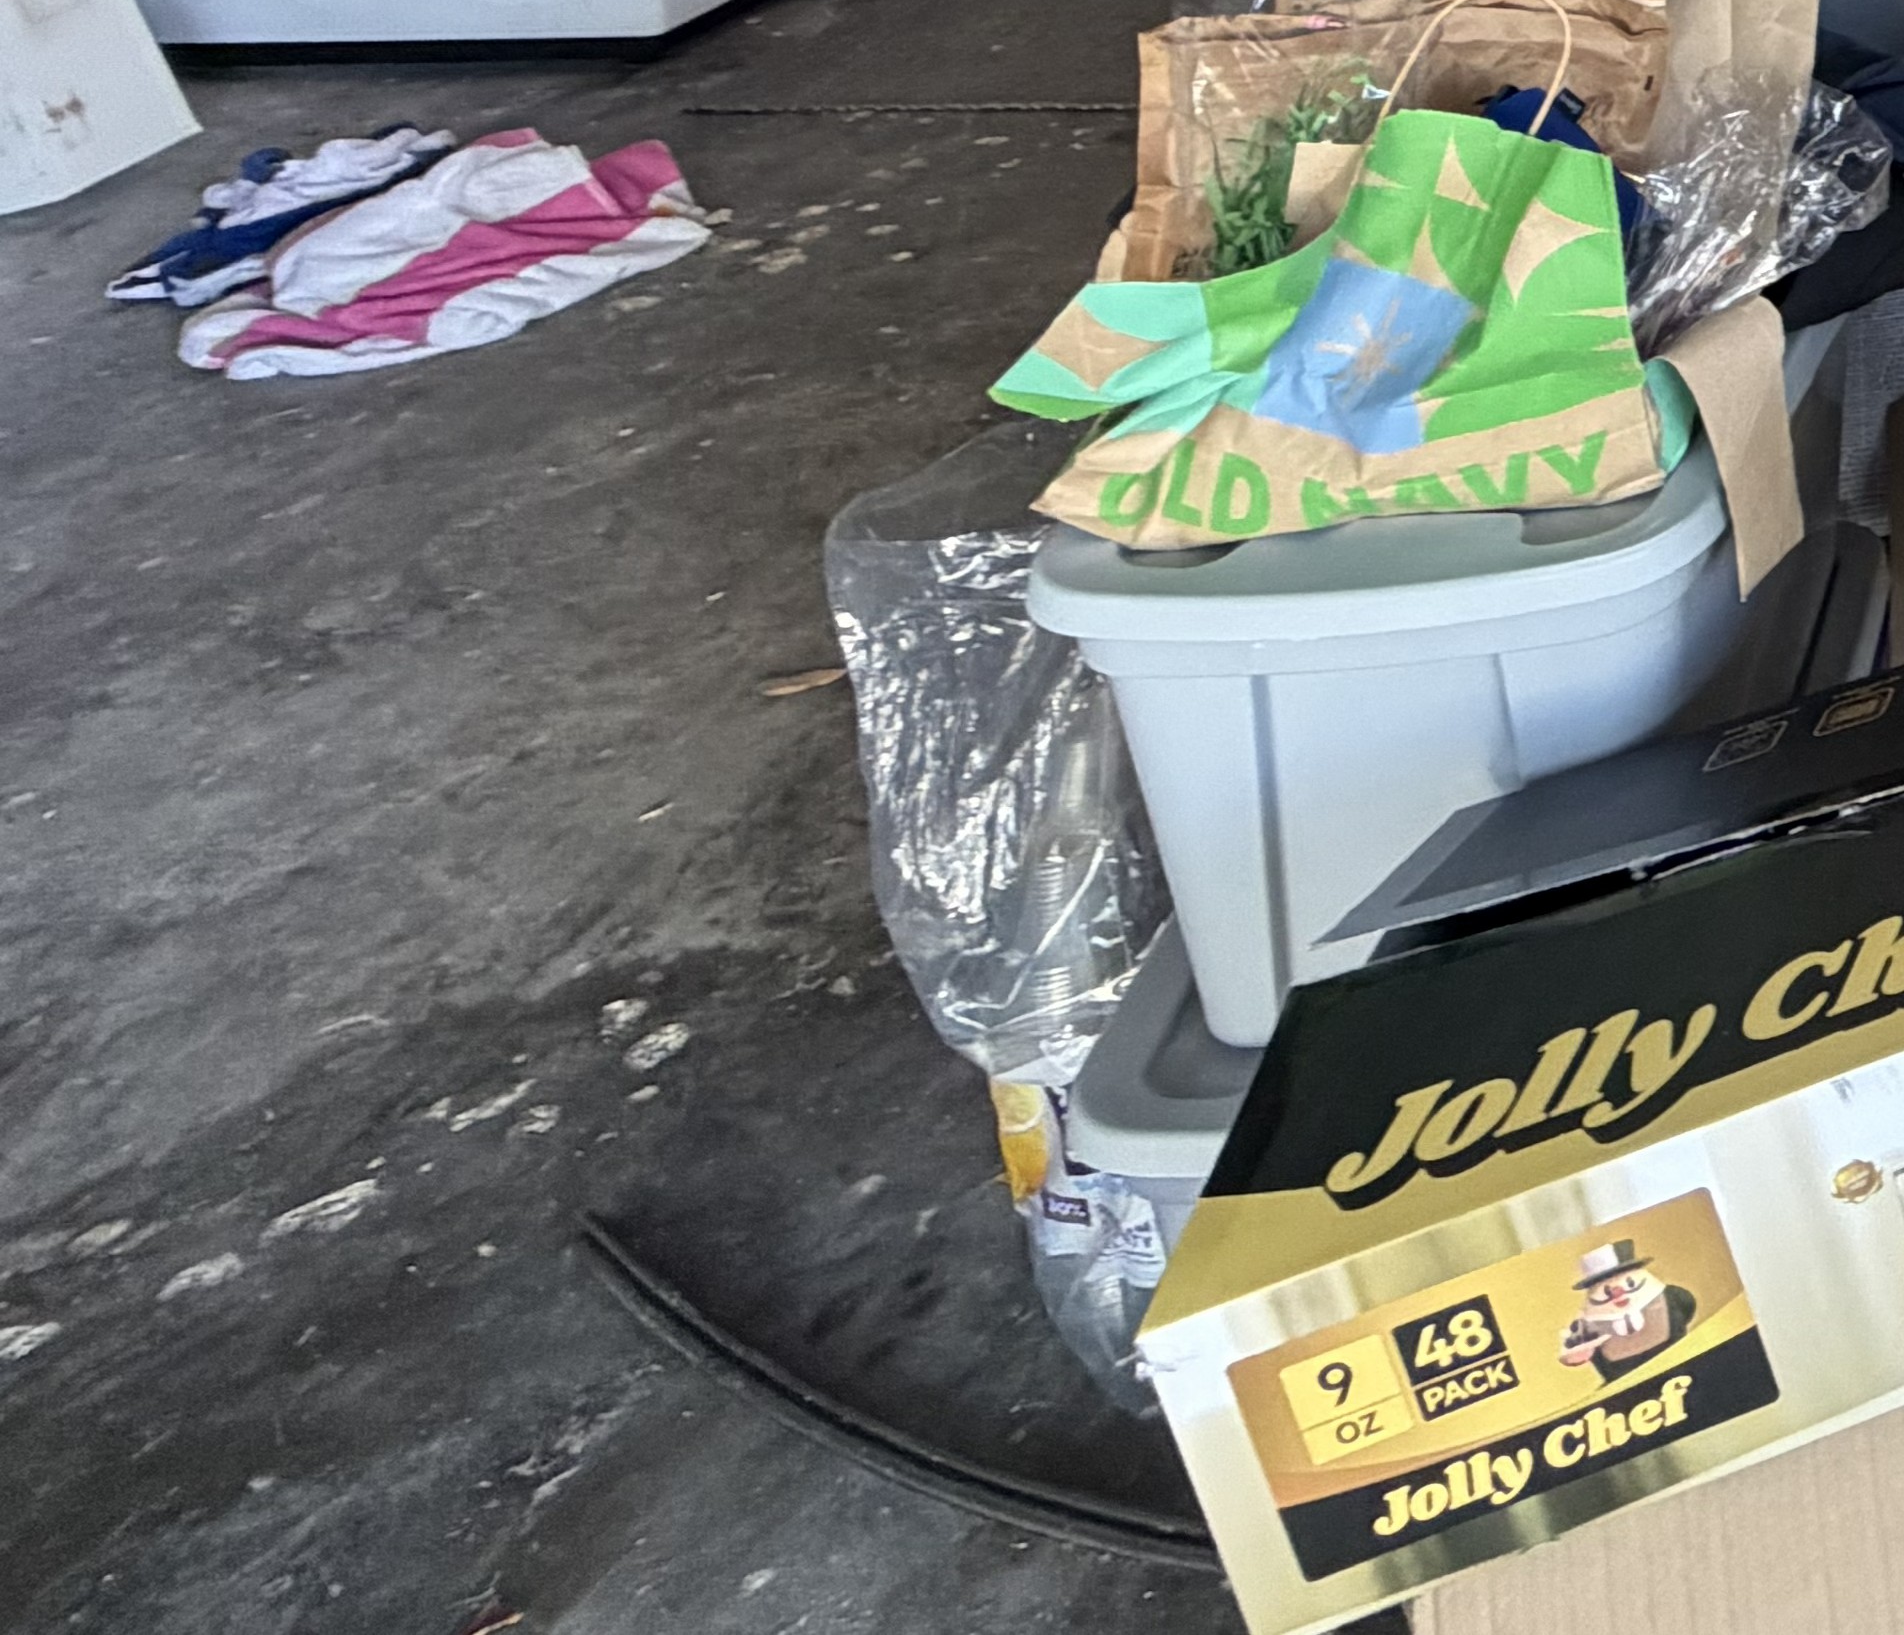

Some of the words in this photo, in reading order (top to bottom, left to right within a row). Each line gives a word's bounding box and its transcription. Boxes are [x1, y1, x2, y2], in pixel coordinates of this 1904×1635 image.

[1099, 437, 1272, 537] OLD
[1301, 430, 1608, 531] NAVY
[1326, 1002, 1718, 1196] Jolly
[1413, 1309, 1495, 1368] 48
[1316, 1361, 1355, 1408] 9
[1421, 1363, 1515, 1413] PACK
[1334, 1410, 1385, 1445] OZ
[1372, 1448, 1534, 1537] Jolly
[1542, 1374, 1694, 1469] Chef
